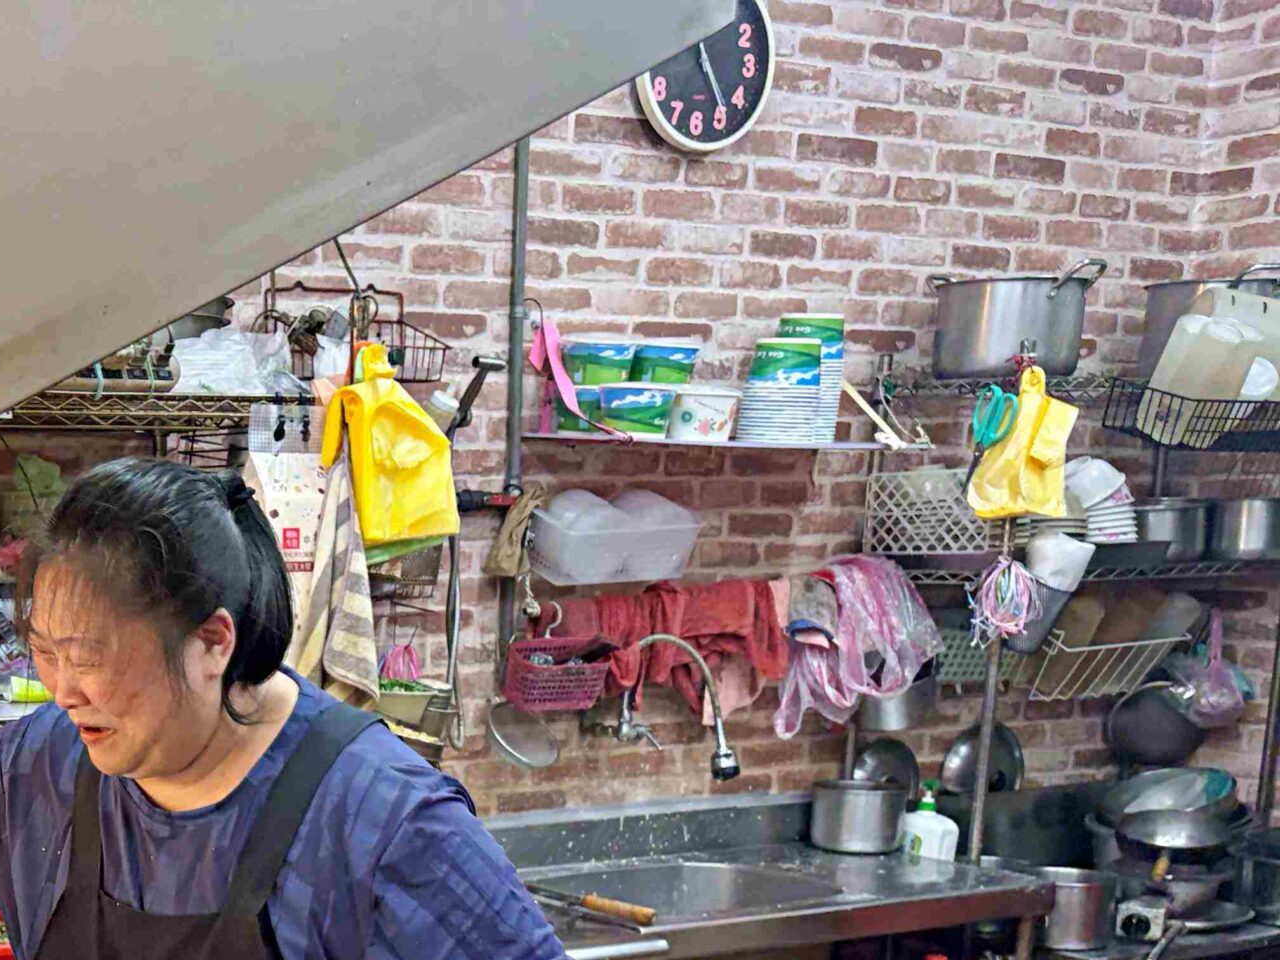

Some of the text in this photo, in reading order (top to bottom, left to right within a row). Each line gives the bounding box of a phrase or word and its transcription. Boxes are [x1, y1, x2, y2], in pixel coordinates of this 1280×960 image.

[738, 23, 752, 48] 2
[742, 53, 756, 78] 3
[653, 75, 667, 101] 8
[731, 84, 745, 110] 4
[670, 101, 684, 126] 7
[689, 111, 703, 136] 6
[712, 104, 727, 130] 5
